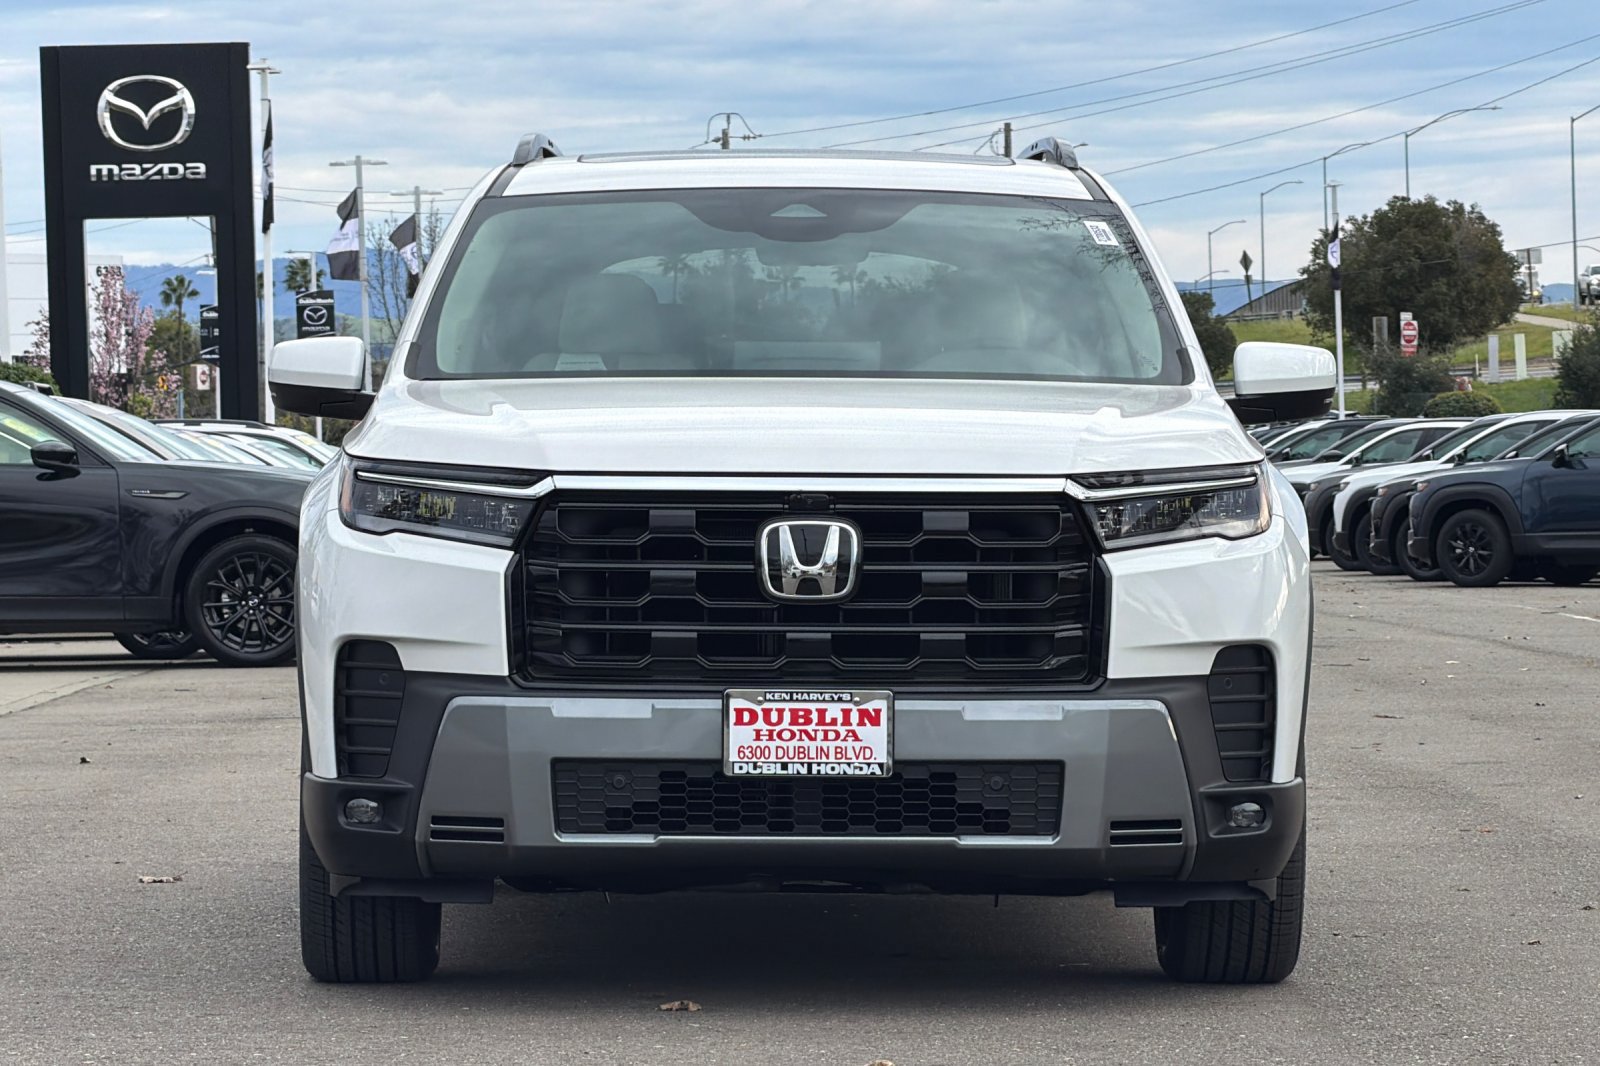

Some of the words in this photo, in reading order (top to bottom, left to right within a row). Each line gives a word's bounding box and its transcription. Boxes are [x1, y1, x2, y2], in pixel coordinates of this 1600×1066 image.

[766, 692, 790, 701] KEN
[793, 692, 851, 701] HARVEY'S
[733, 707, 882, 727] DUBLIN
[752, 728, 863, 742] HONDA
[737, 745, 771, 760] 6300
[775, 745, 830, 760] DUBLIN
[834, 746, 877, 760] BLVD.
[733, 762, 808, 774] DUBLIN
[811, 763, 882, 775] HONDA
